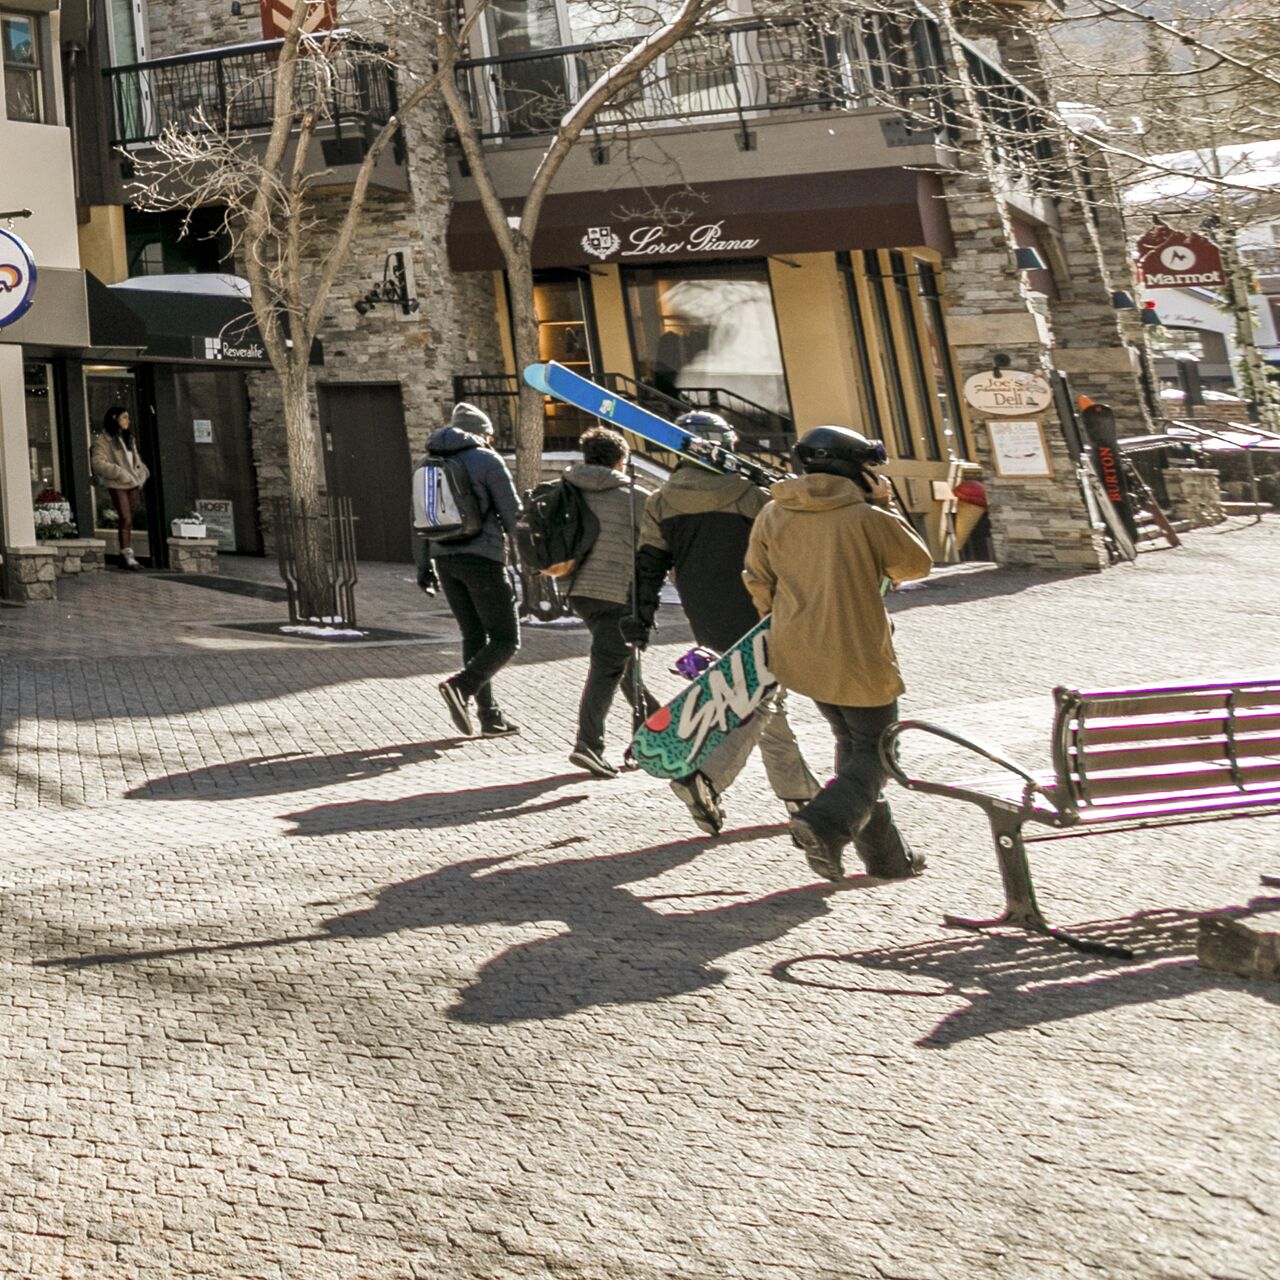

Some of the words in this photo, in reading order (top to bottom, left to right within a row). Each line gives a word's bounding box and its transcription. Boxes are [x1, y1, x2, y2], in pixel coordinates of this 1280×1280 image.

[621, 226, 685, 256] Loro
[687, 220, 760, 252] Piana
[1145, 271, 1222, 286] Marmot
[993, 388, 1024, 406] Deli
[1099, 447, 1121, 502] BURTON
